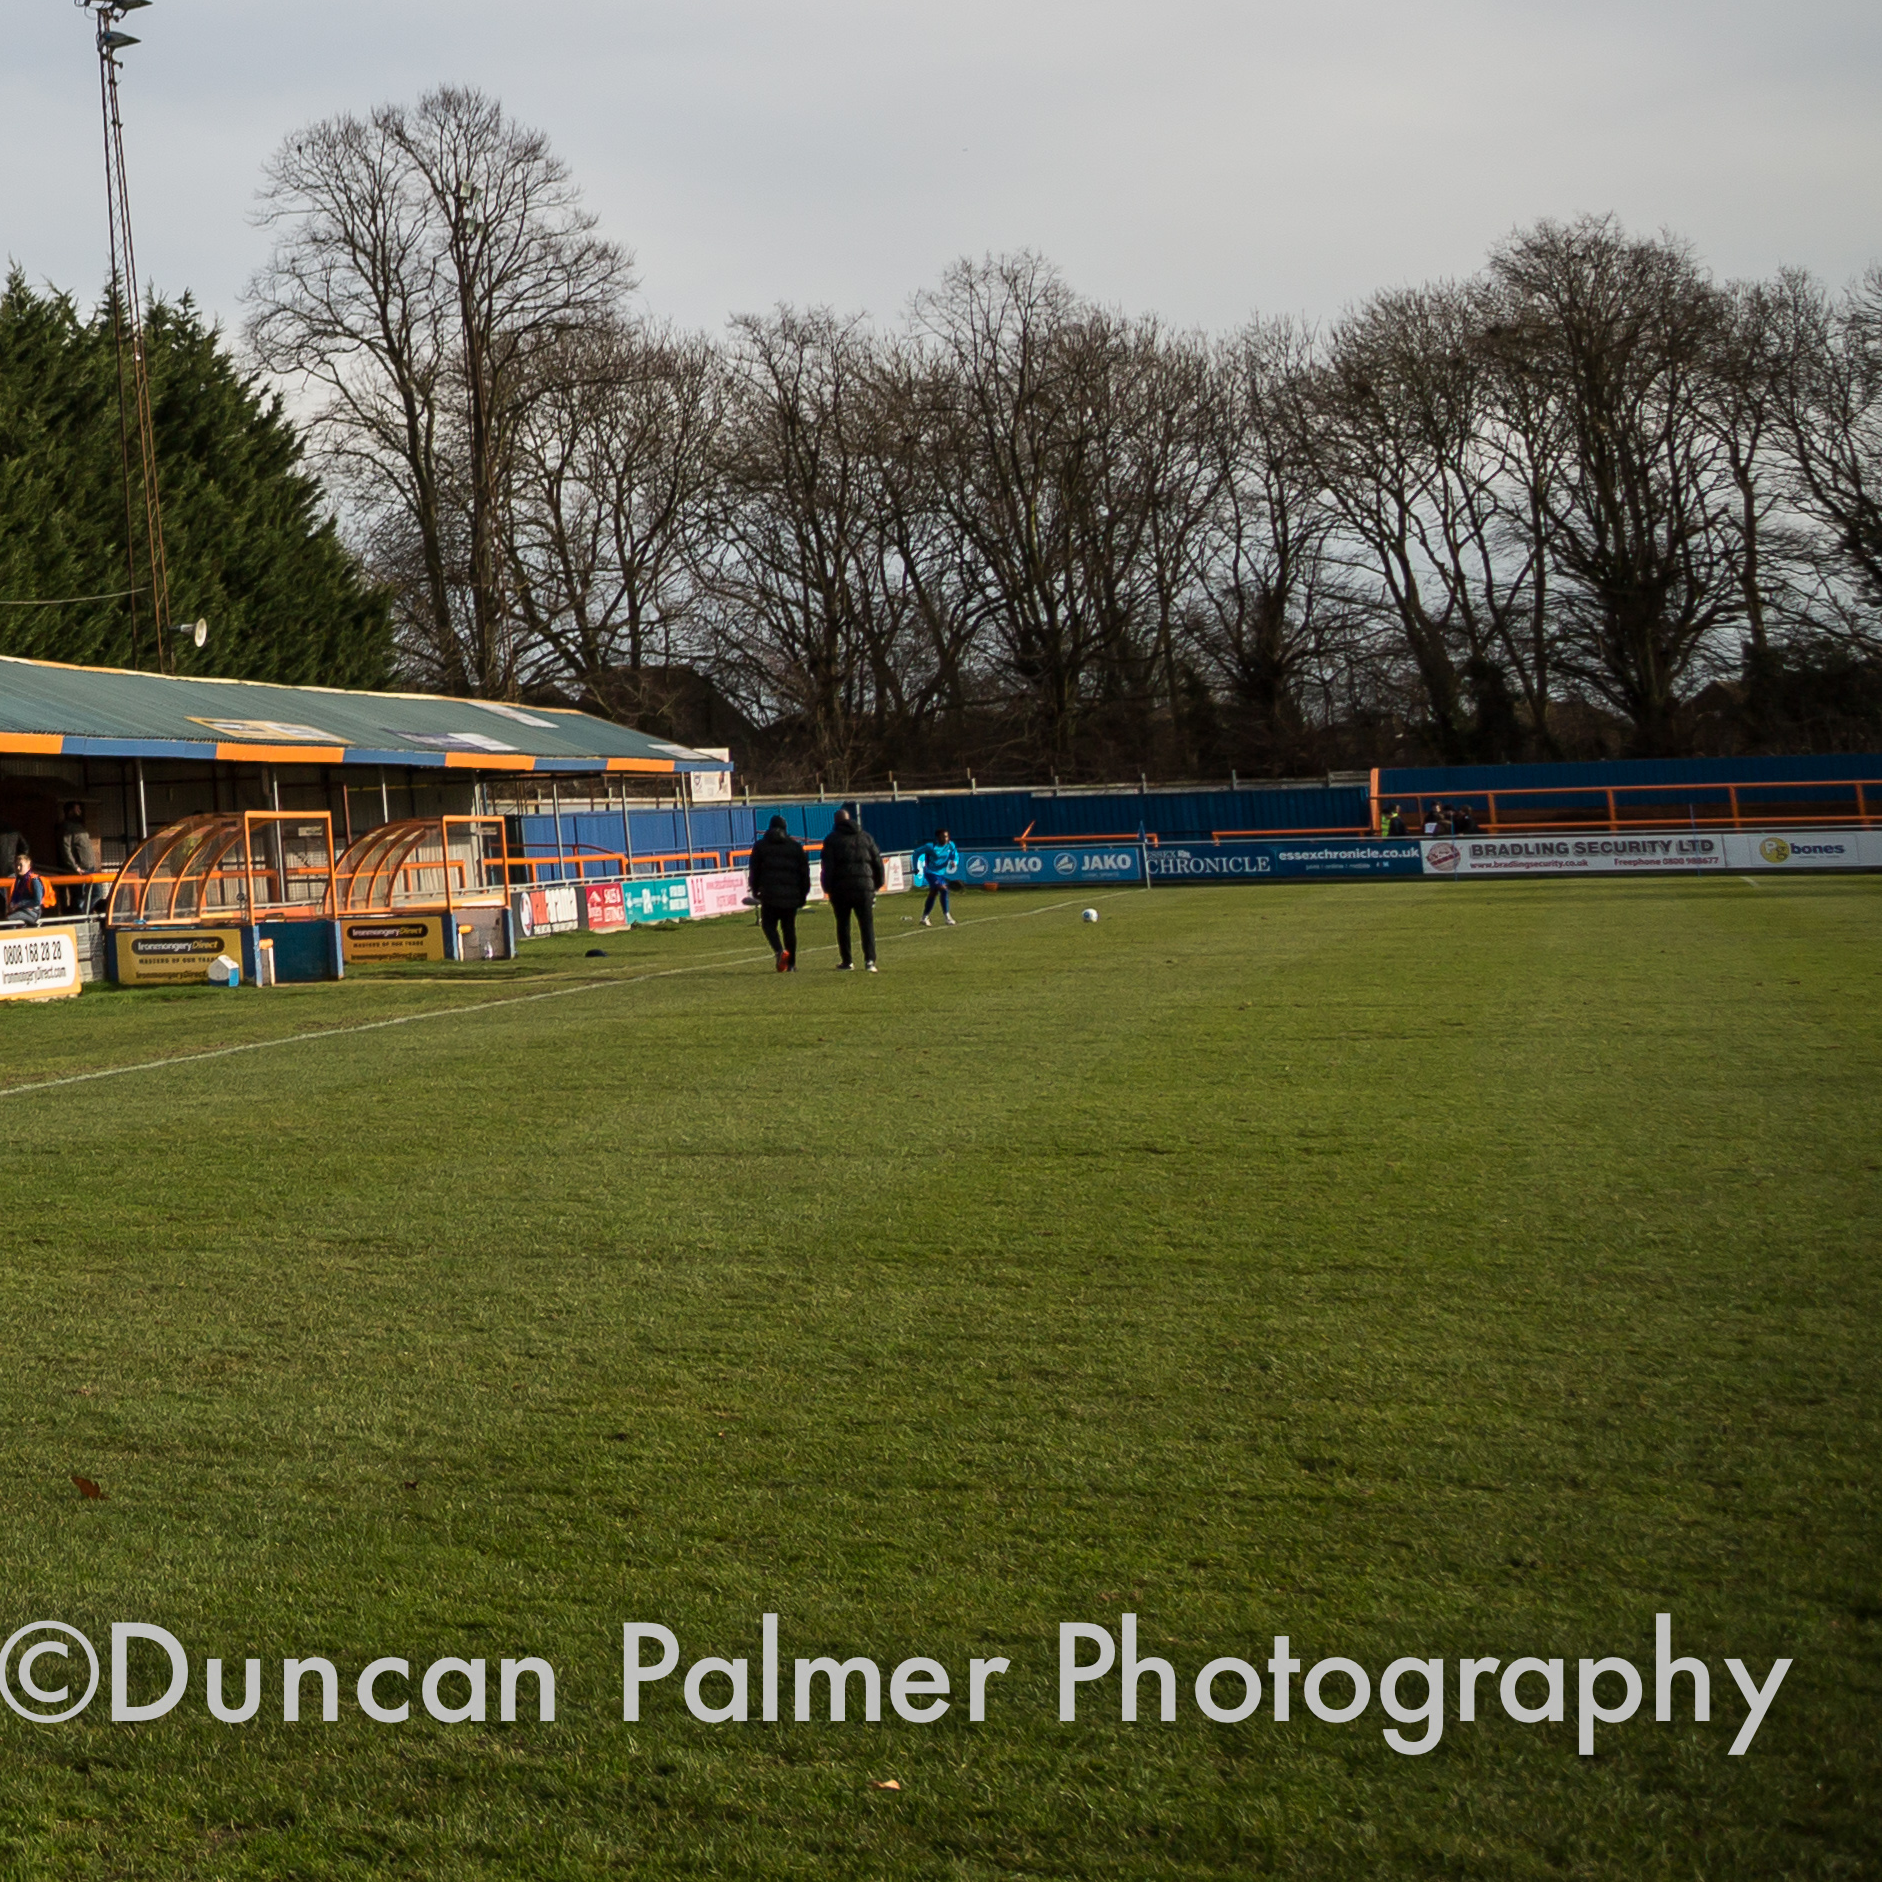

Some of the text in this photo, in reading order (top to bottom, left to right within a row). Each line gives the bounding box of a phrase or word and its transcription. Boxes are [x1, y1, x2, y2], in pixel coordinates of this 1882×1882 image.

[1279, 847, 1420, 861] essexchronicle.co.uk
[1471, 839, 1715, 858] BRADLING SECURITY LTD
[1790, 843, 1845, 854] bones
[993, 856, 1042, 874] JAKO
[1081, 854, 1131, 871] JAKO
[1147, 856, 1271, 874] CHRONICLE
[3, 940, 62, 966] 0808 168 28 28
[138, 940, 219, 952] IronmongeryDirect
